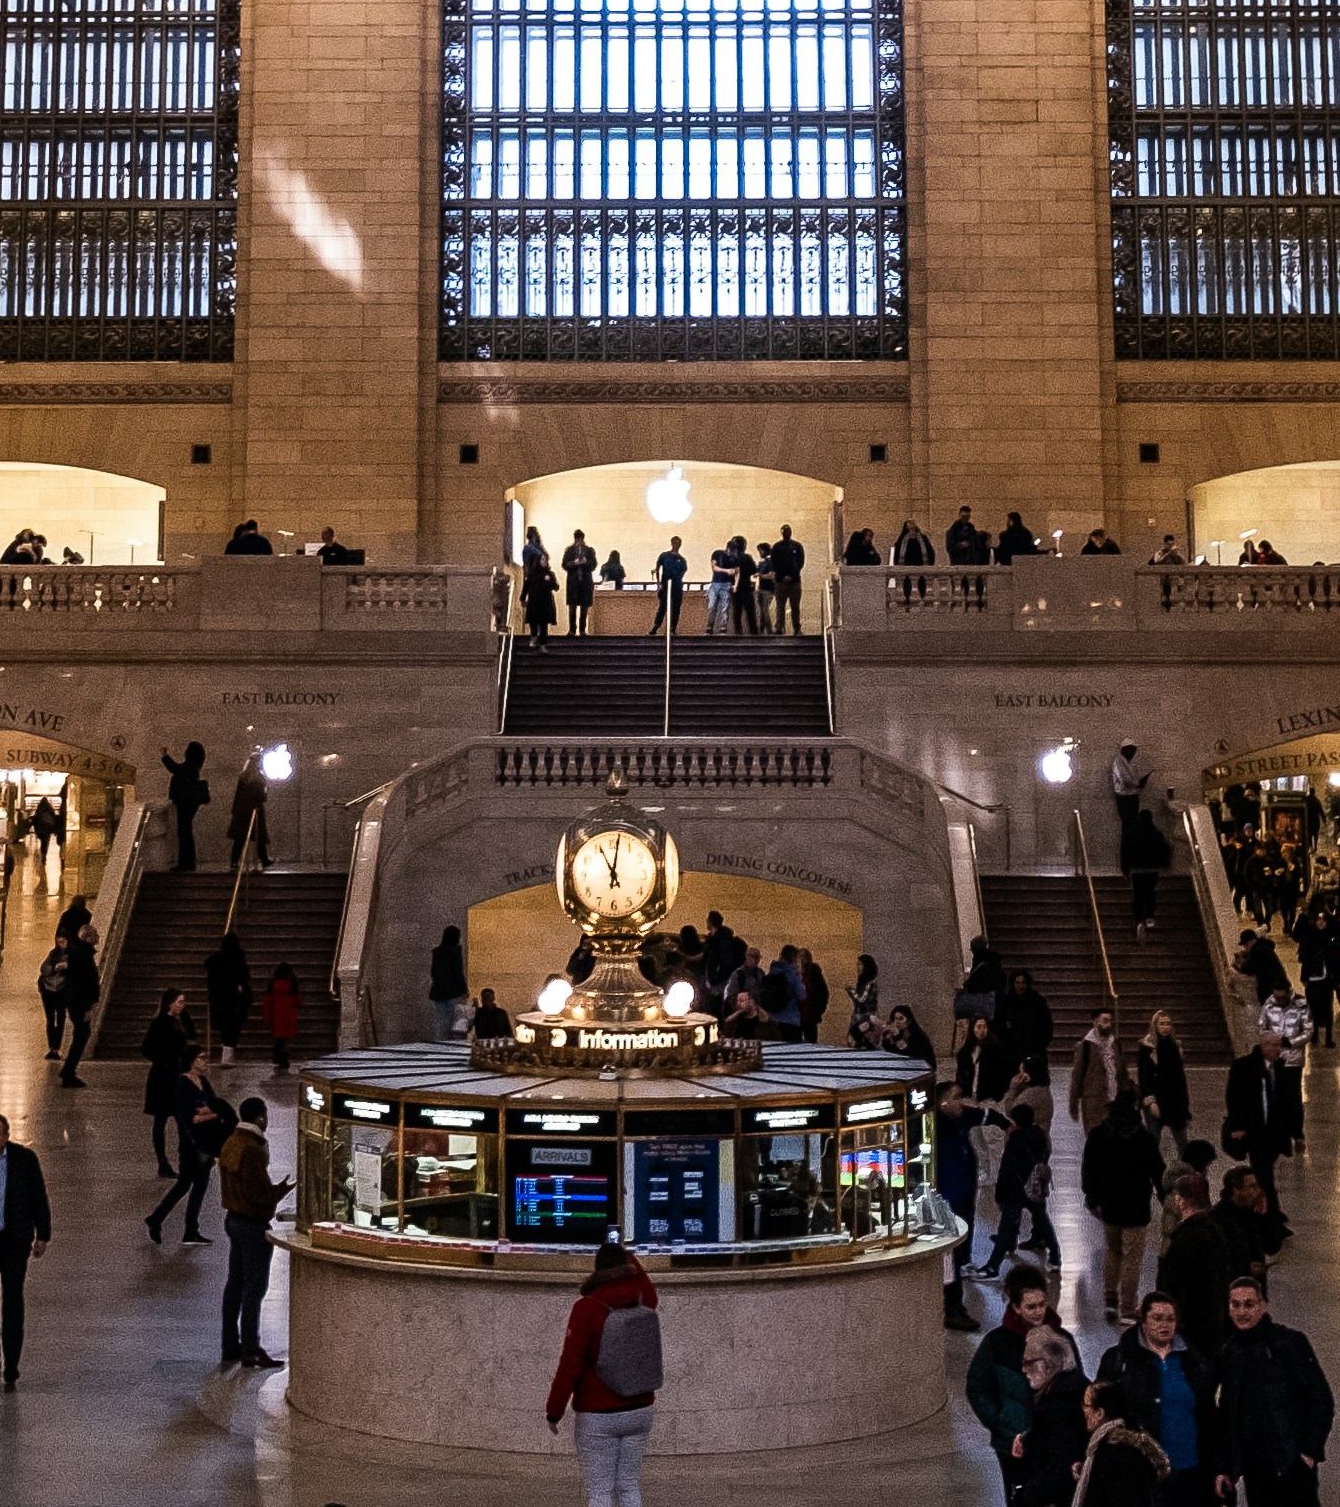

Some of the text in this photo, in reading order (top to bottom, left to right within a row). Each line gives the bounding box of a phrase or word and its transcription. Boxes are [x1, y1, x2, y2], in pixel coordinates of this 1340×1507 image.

[222, 692, 341, 705] EAST BALCONY
[995, 694, 1115, 707] EAST BALCONY
[25, 709, 66, 732] AVE
[6, 749, 78, 767] SUBWAY
[1236, 754, 1303, 776] STREET
[705, 852, 853, 893] DINING CONCOURSE
[579, 1028, 678, 1049] Information
[534, 1150, 589, 1163] ARRIVALS
